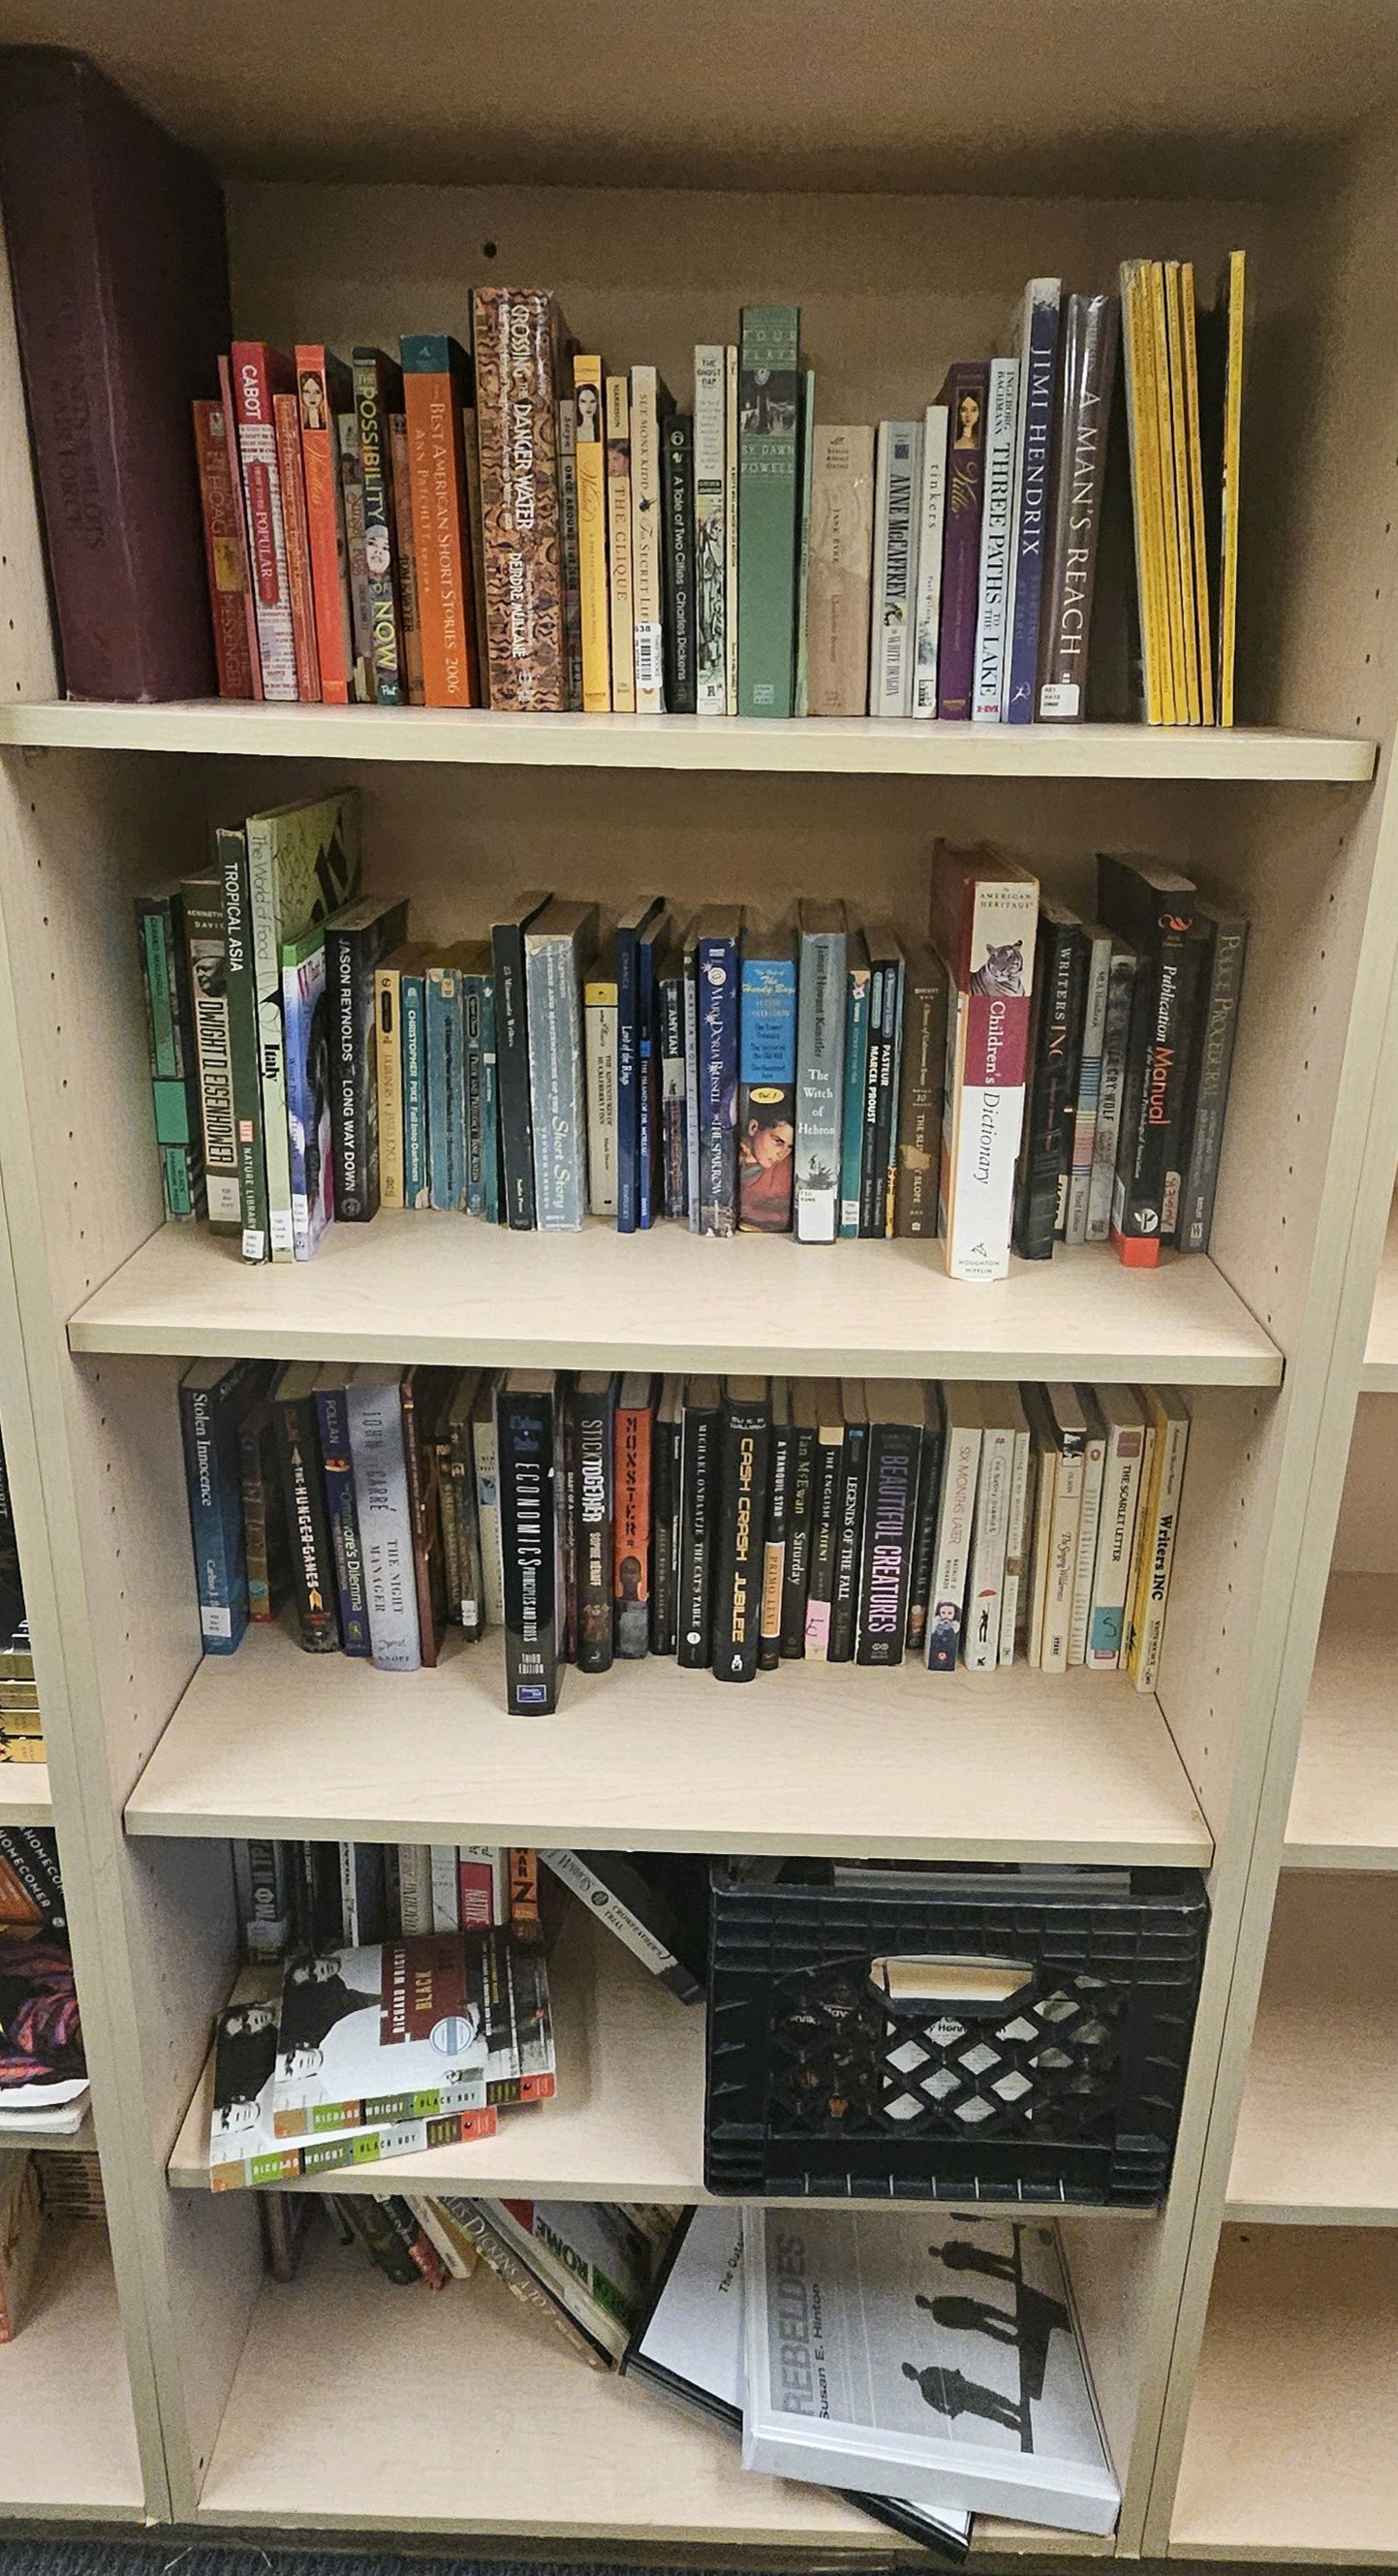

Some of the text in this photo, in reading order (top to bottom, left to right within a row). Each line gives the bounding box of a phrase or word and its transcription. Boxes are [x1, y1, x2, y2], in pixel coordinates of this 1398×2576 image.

[241, 363, 262, 420] CABOT
[510, 304, 536, 529] CROSSING DANGER WATER
[1079, 390, 1101, 408] A
[359, 388, 385, 522] POSSIBILITY
[415, 429, 426, 462] ANN
[639, 415, 650, 489] MONK KIDD
[1022, 348, 1052, 556] JIMI HENDRIX
[1070, 424, 1099, 528] MAN'S
[928, 463, 941, 530] tinkers
[984, 443, 1011, 603] THREE PATHS
[255, 511, 272, 579] POPULAR
[430, 402, 460, 694] BEST AMERICAN SHORT STORIES 2006
[614, 486, 628, 601] THE CLIQUE
[638, 544, 651, 594] SECRET
[885, 474, 911, 598] ANNE McCAFFREY
[507, 552, 526, 658] DEIRDRE MULLANE
[674, 487, 688, 681] Tale of Two Cities Charles Dickens
[1060, 548, 1089, 655] REACH
[374, 601, 397, 673] NOW
[979, 636, 1000, 696] LAKE
[225, 863, 243, 972] TROPICAL ASIA
[251, 835, 273, 959] The World Food
[979, 891, 1031, 900] AMERICAN
[980, 900, 1033, 909] HERITAGE
[1054, 947, 1072, 1021] WRITERS
[1216, 935, 1241, 992] POLICE
[198, 1000, 226, 1055] DWIGHT
[620, 1024, 633, 1085] Lord Rings
[668, 1009, 679, 1034] AMY
[985, 1000, 1006, 1084] Children's
[1047, 1023, 1067, 1064] INC
[1149, 965, 1178, 1126] Publication Manual
[1203, 996, 1235, 1099] PROCEDURAL
[263, 1043, 280, 1083] Italy
[338, 938, 358, 1191] JASON REYNOLDS LONG WAY DOWN
[408, 1010, 419, 1103] CHRISTOPHER PIKE
[709, 1061, 723, 1103] RUSSELL
[808, 1069, 828, 1082] The
[866, 1046, 880, 1123] MARCEL PROUST
[880, 1045, 891, 1085] PASTEUR
[1142, 1067, 1151, 1096] American
[203, 1073, 234, 1164] EISENHOWER
[803, 1087, 833, 1100] Witch
[812, 1106, 824, 1118] of
[916, 1115, 926, 1132] THE
[1102, 1069, 1119, 1122] CRY WOLF
[1137, 1098, 1149, 1142] Psychological
[410, 1142, 420, 1180] Darkness
[551, 1115, 571, 1209] Short Story
[798, 1124, 835, 1136] Hebron
[975, 1089, 1002, 1185] Dictionary
[242, 1147, 254, 1184] NATURE
[710, 1142, 723, 1196] SPARROW
[913, 1175, 923, 1204] SLOPE
[1074, 1189, 1083, 1209] Third
[245, 1189, 257, 1229] LIBRARY
[193, 1393, 212, 1506] Stolen Innocence
[326, 1399, 339, 1445] POLLAN
[361, 1411, 383, 1449] JOHN
[625, 1417, 638, 1536] MONSTER
[694, 1424, 707, 1536] MICHAEL ONDAATJE
[737, 1437, 754, 1492] CASH
[772, 1451, 786, 1518] TRANQUIL STAR
[794, 1435, 813, 1515] Ian McEwan
[949, 1445, 972, 1545] SIX MONTHS LATER
[295, 1487, 319, 1588] HUNGER GAMES
[514, 1461, 543, 1566] ECONOMICS
[735, 1496, 752, 1561] CRASH
[819, 1451, 835, 1562] THE ENGLISH PATIENT
[837, 1476, 858, 1601] LEGENDS OF THE FALL
[1111, 1464, 1133, 1562] THE SCARLET LETTER
[387, 1539, 400, 1567] THE
[788, 1531, 807, 1586] Saturday
[869, 1455, 908, 1633] BEAUTIFUL CREATURES
[1151, 1514, 1174, 1602] Writers INC
[345, 1560, 363, 1613] Dilemma
[368, 1545, 387, 1614] MANAGER
[388, 1572, 404, 1616] NIGHT
[521, 1566, 537, 1620] PRINCIPLES AND
[691, 1542, 704, 1628] THE TABLE
[731, 1571, 748, 1644] JUBILEE
[415, 1970, 433, 2011] BLACK
[365, 2100, 404, 2117] WRIGHT
[419, 2094, 454, 2111] BLACK
[457, 2090, 477, 2103] BOY
[305, 2148, 345, 2165] WRIGHT
[358, 2136, 394, 2153] BLACK
[398, 2133, 417, 2146] BOY
[778, 2231, 813, 2416] REBELDES
[812, 2283, 830, 2420] Hinton Susan
